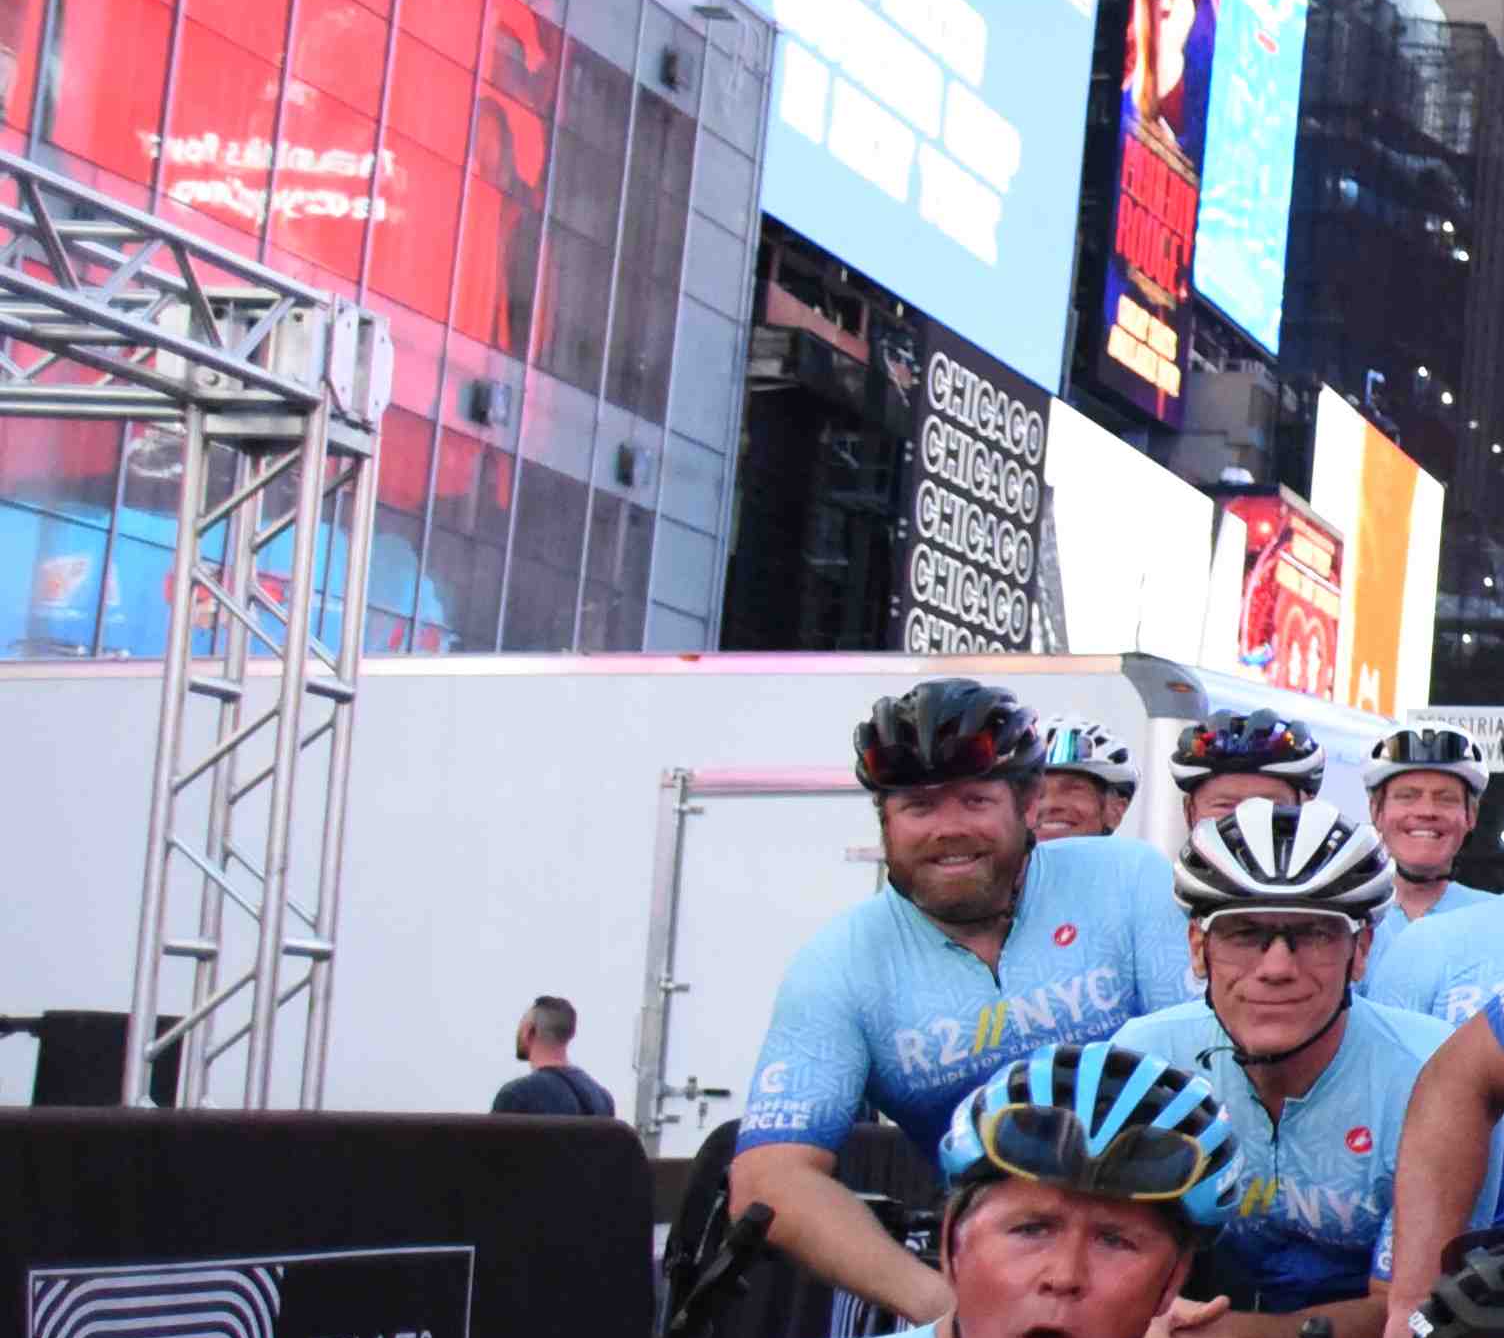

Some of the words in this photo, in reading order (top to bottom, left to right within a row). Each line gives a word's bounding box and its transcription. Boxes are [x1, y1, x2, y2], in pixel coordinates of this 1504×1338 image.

[927, 351, 1044, 464] CHICAGO
[922, 415, 1039, 525] CHICAGO
[916, 479, 1034, 584] CHICAGO
[910, 542, 1029, 644] CHICAGO
[895, 966, 1121, 1073] R2//NYC
